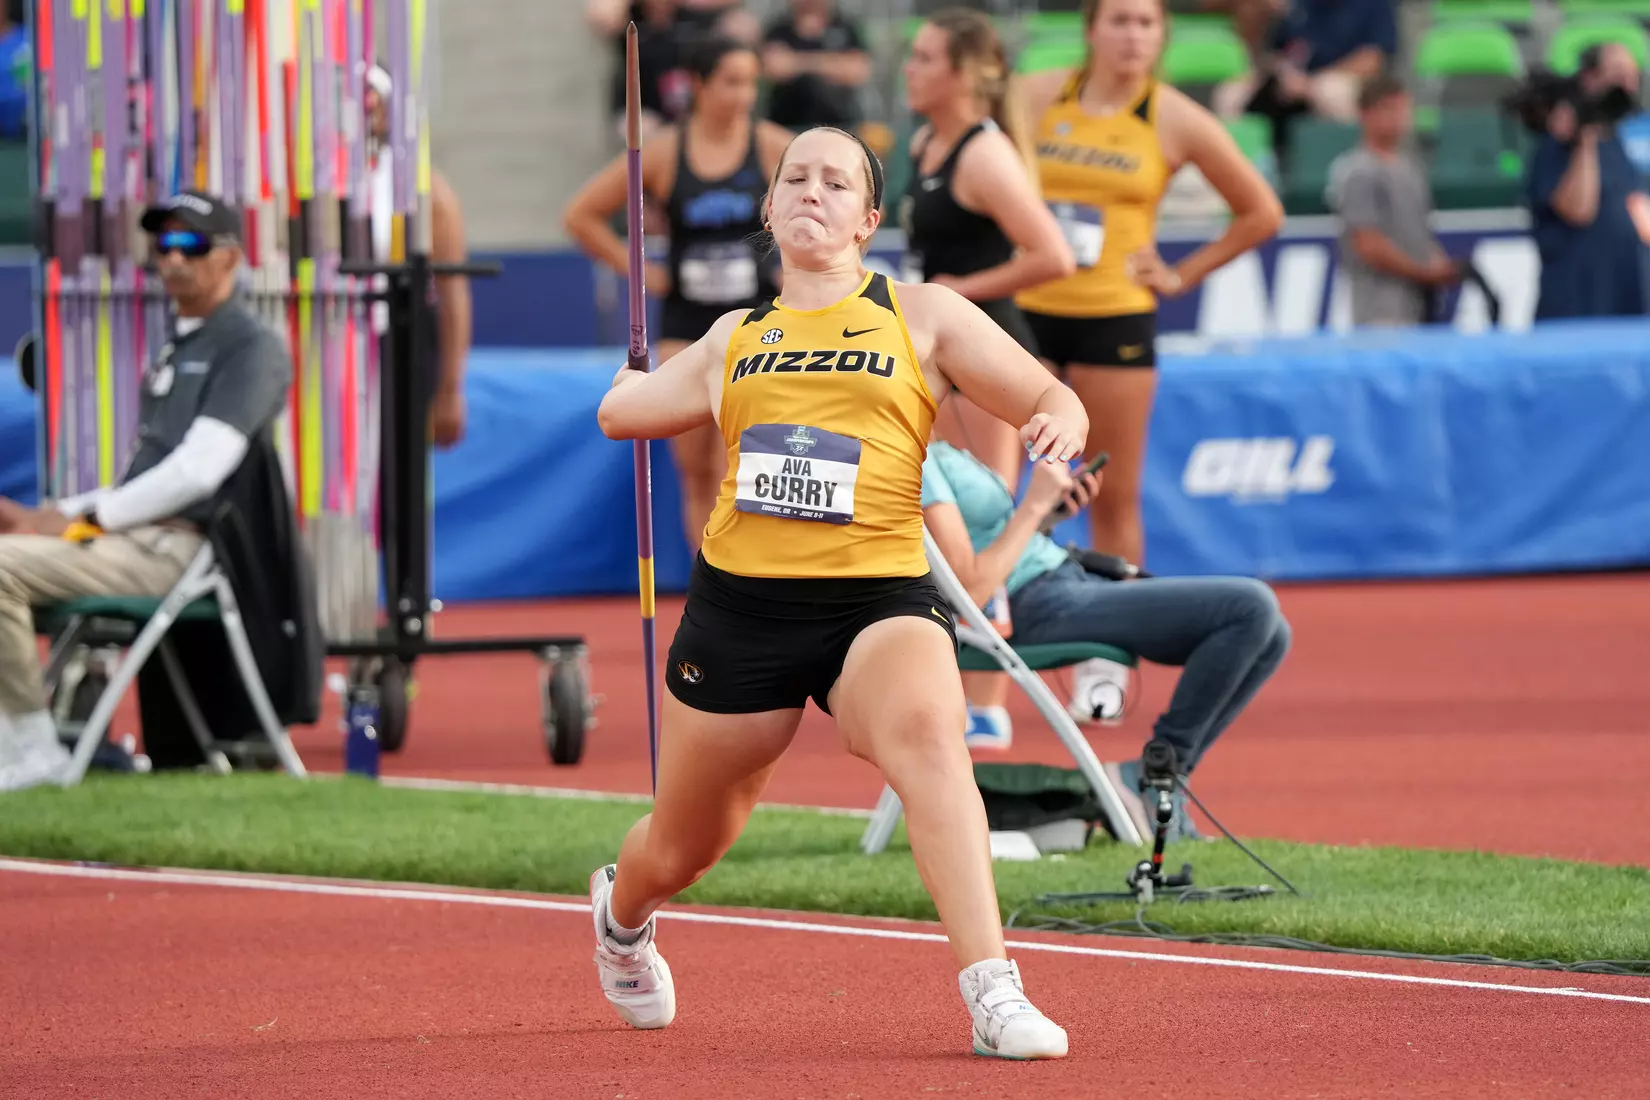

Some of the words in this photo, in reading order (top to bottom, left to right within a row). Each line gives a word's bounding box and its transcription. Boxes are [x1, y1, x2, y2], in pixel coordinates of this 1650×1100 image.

[761, 328, 783, 344] SEC
[731, 350, 895, 384] MIZZOU
[782, 458, 812, 476] AVA
[755, 473, 838, 507] CURRY
[615, 980, 639, 988] NIKE
